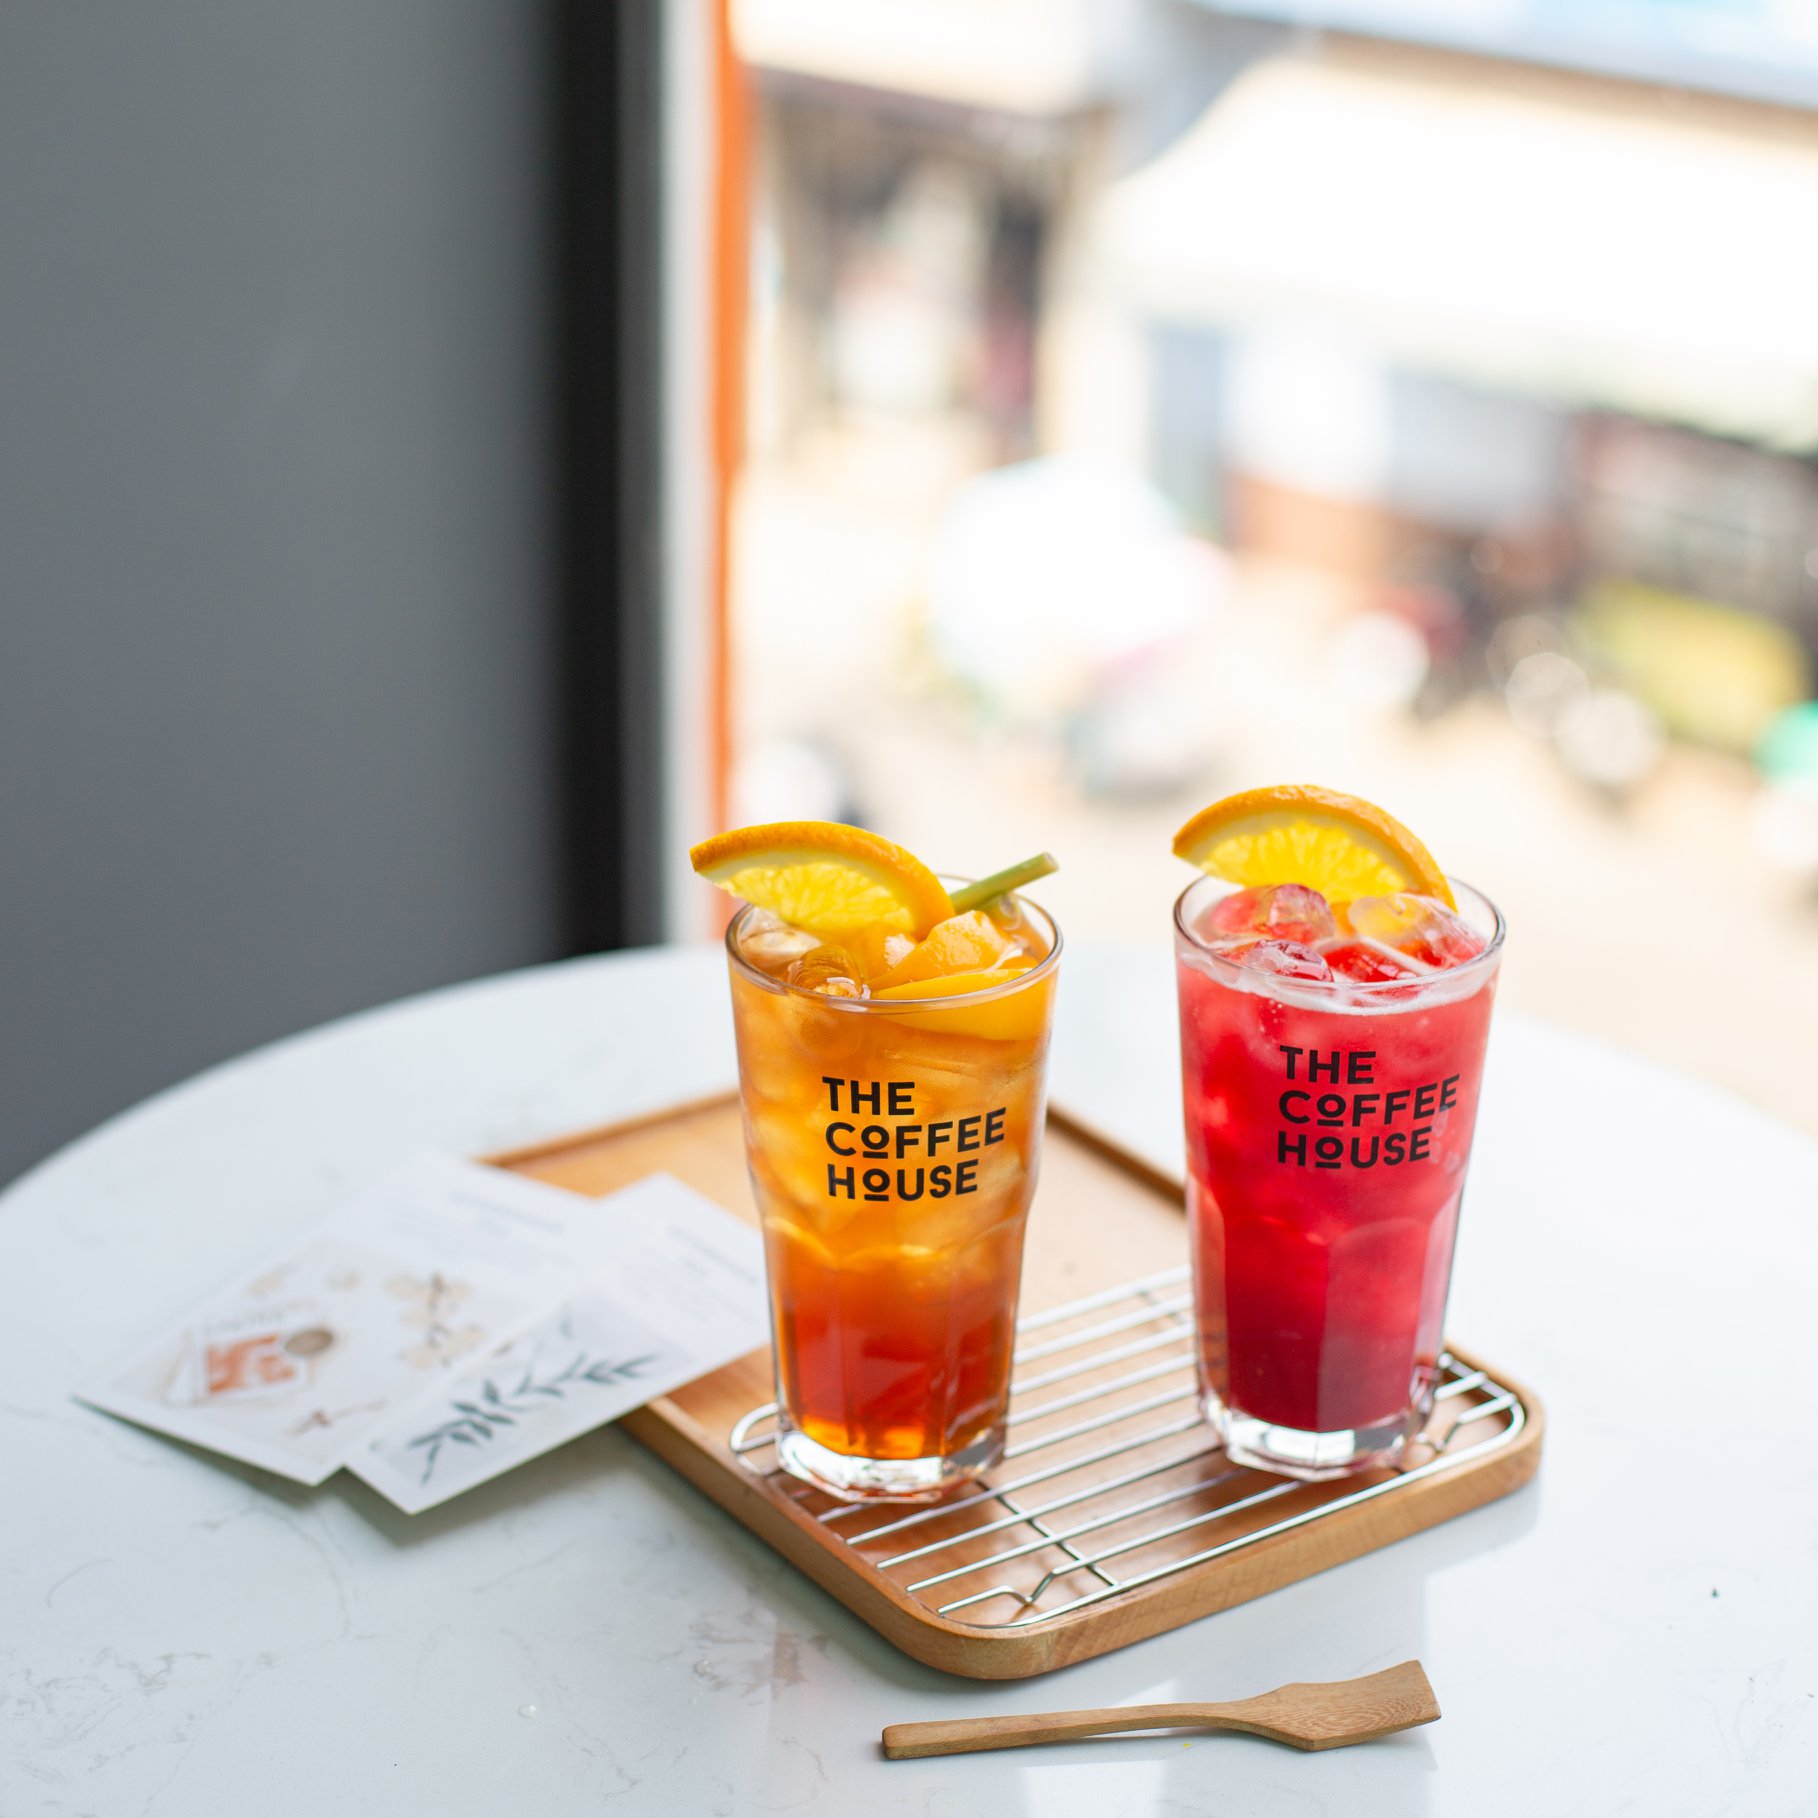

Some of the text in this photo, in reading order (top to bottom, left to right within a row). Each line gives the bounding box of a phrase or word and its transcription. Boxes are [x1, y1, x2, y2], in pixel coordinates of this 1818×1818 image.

[1279, 1045, 1376, 1085] THE
[822, 1076, 915, 1116] THE
[1278, 1074, 1460, 1127] COFFEE
[825, 1107, 1006, 1159] COFFEE
[1277, 1126, 1433, 1169] HOUSE
[827, 1159, 979, 1202] HOUSE
